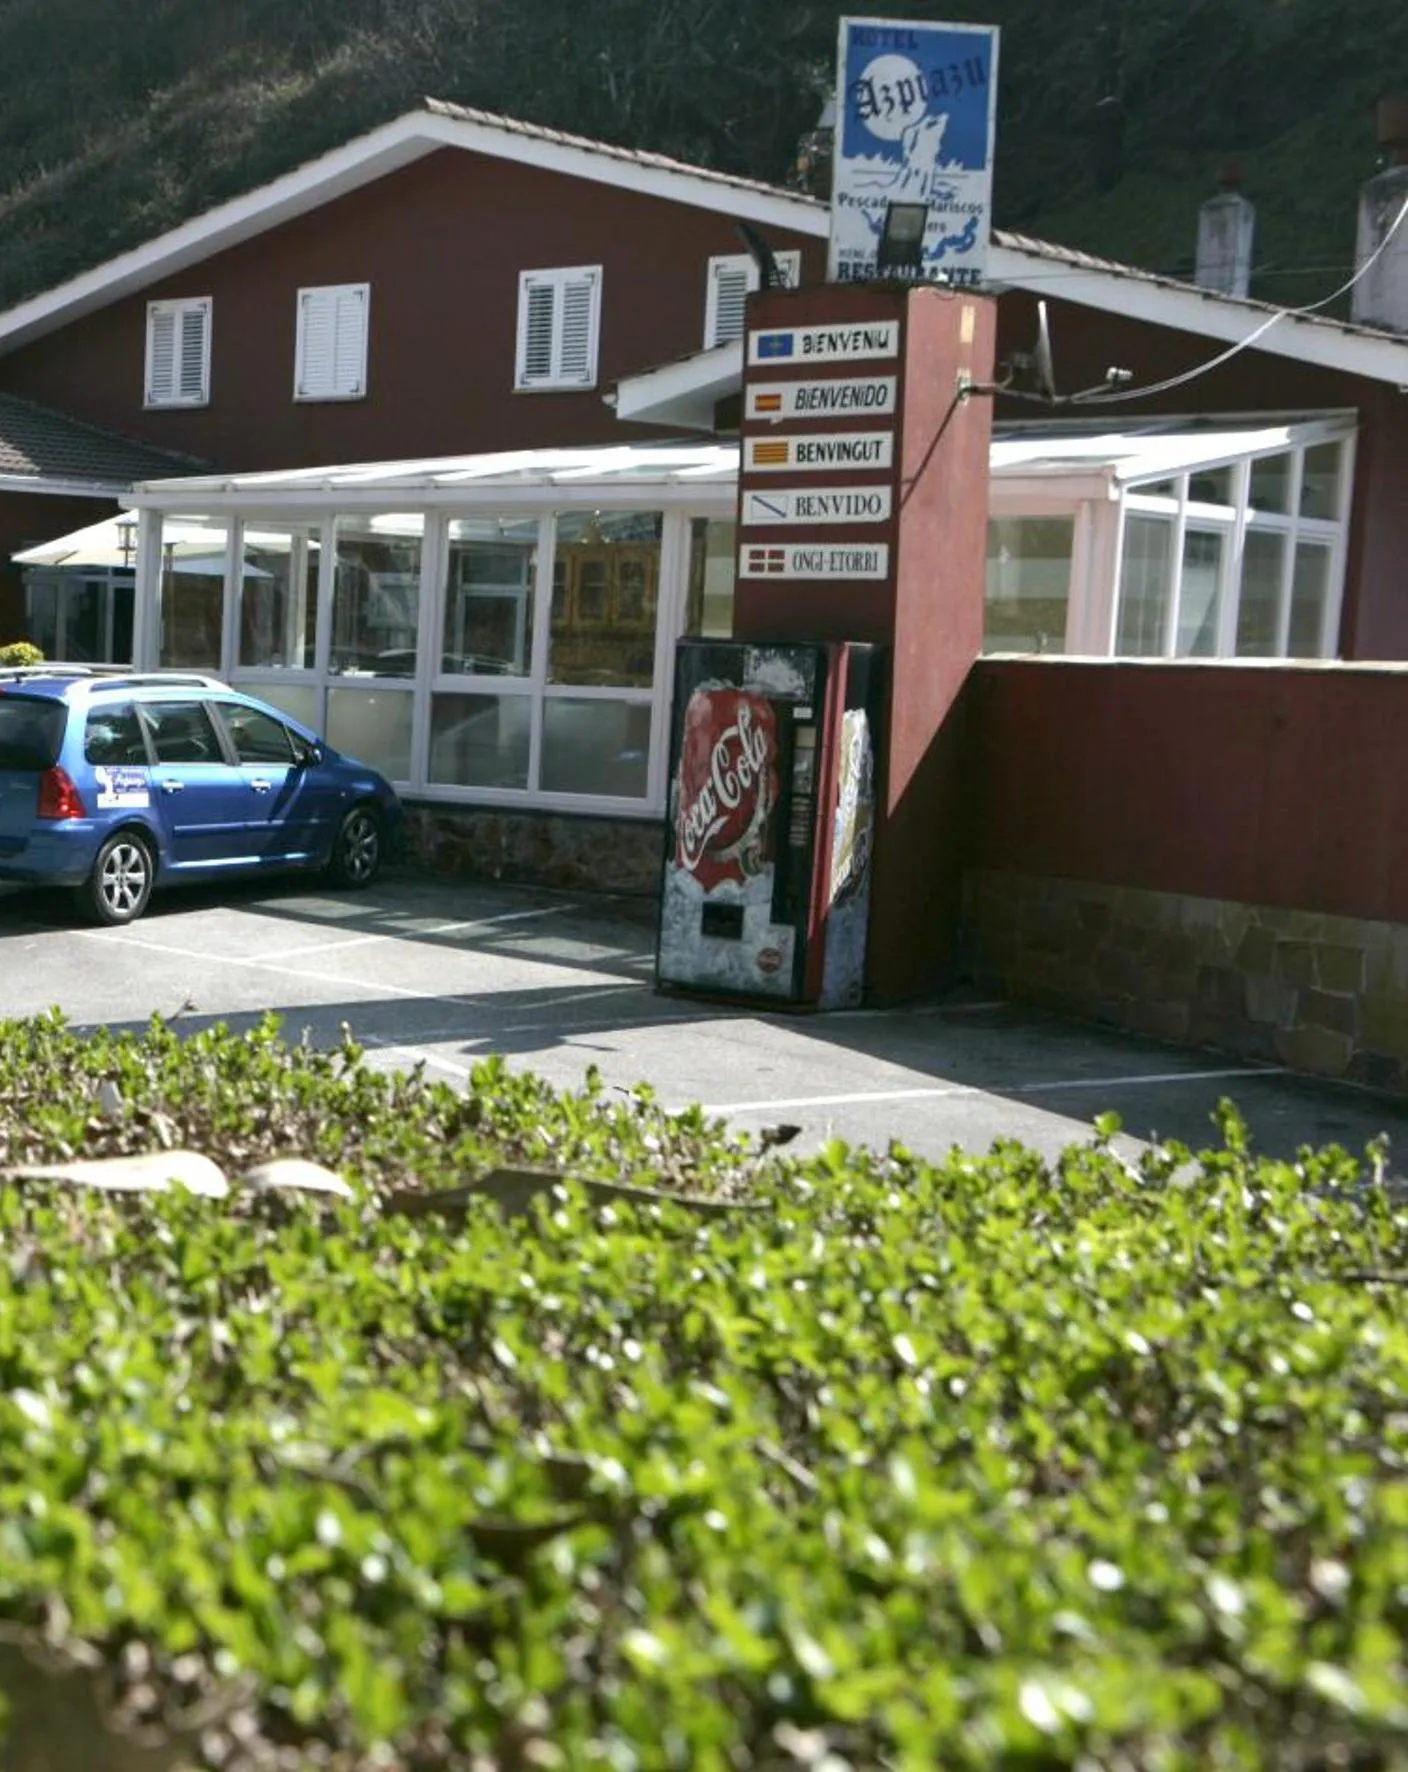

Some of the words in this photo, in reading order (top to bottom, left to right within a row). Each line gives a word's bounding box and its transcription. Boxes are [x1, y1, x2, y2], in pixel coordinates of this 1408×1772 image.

[851, 27, 919, 49] HOTEL
[796, 440, 884, 462] BENVINGUT
[795, 494, 882, 516] BENVIDO
